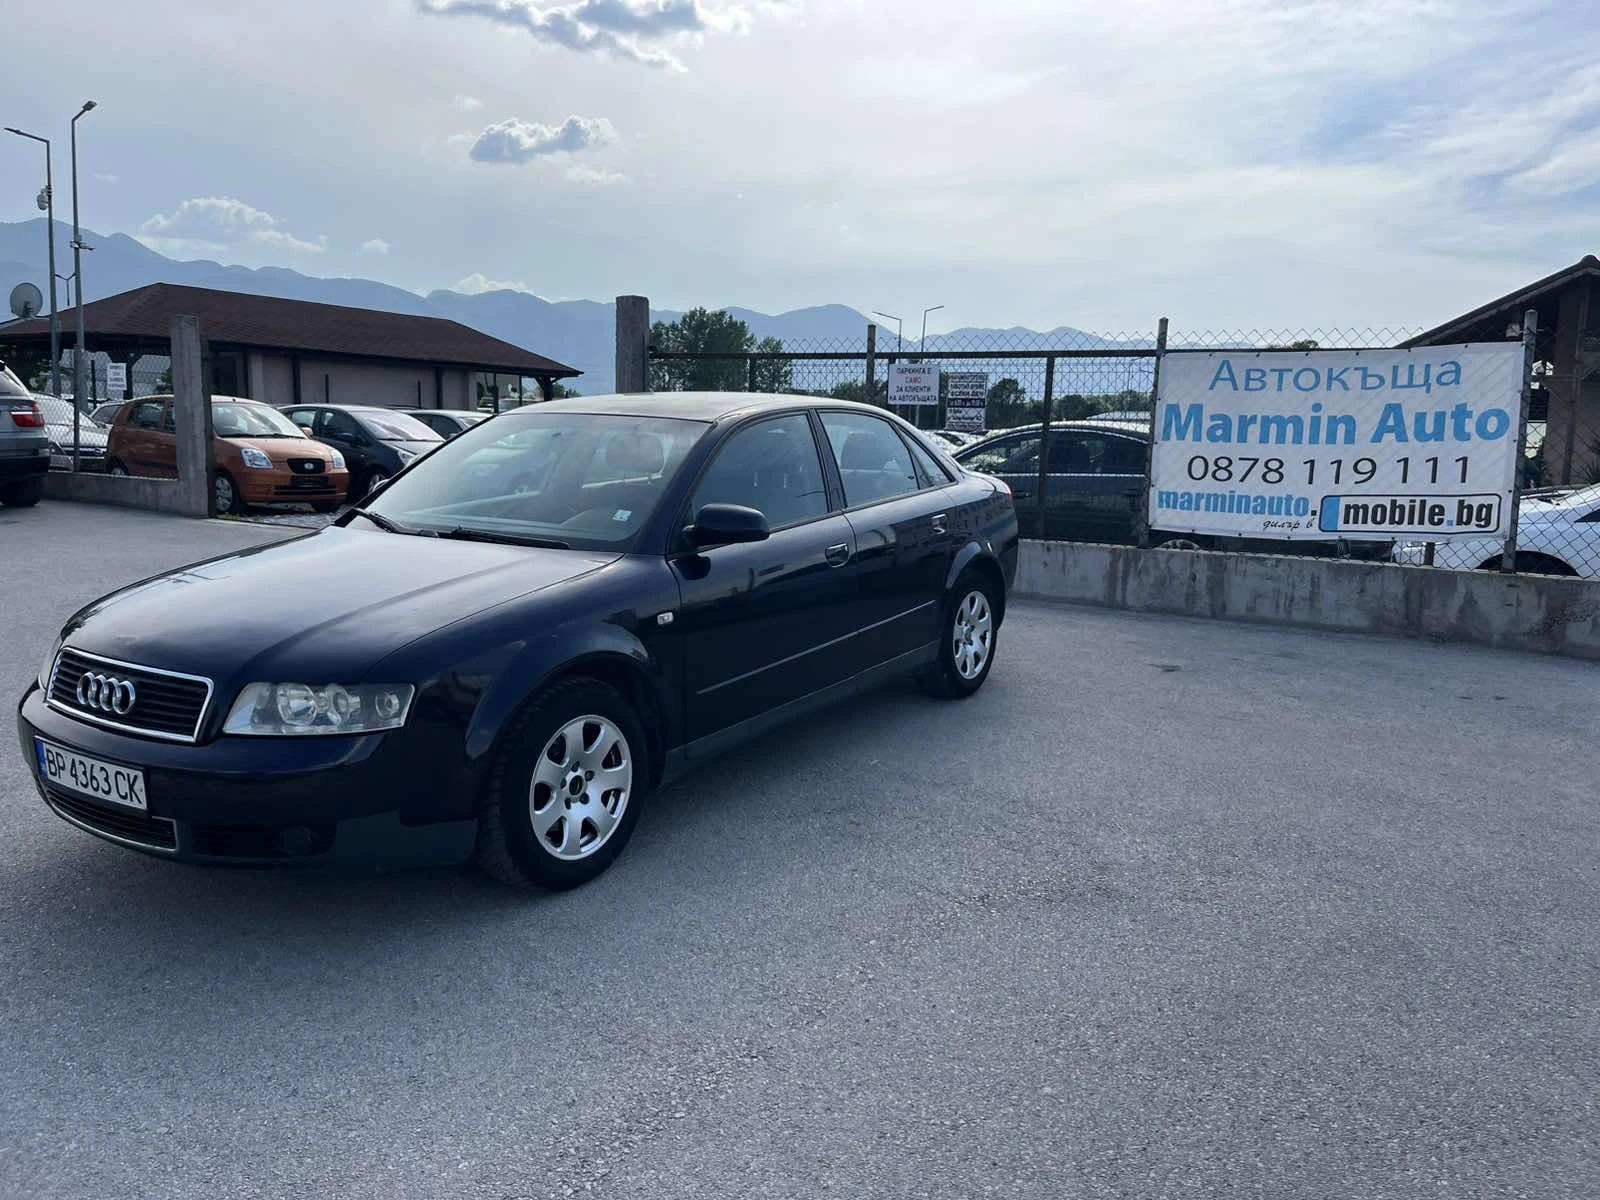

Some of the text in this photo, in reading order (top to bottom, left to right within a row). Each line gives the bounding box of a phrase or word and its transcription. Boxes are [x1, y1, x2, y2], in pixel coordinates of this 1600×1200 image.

[1208, 359, 1463, 393] Автокъща
[1160, 402, 1511, 445] Marmin Auto
[1187, 455, 1469, 485] 0878 119 111
[1343, 499, 1494, 528] mobile.bg
[46, 749, 142, 804] BP 4363 CK
